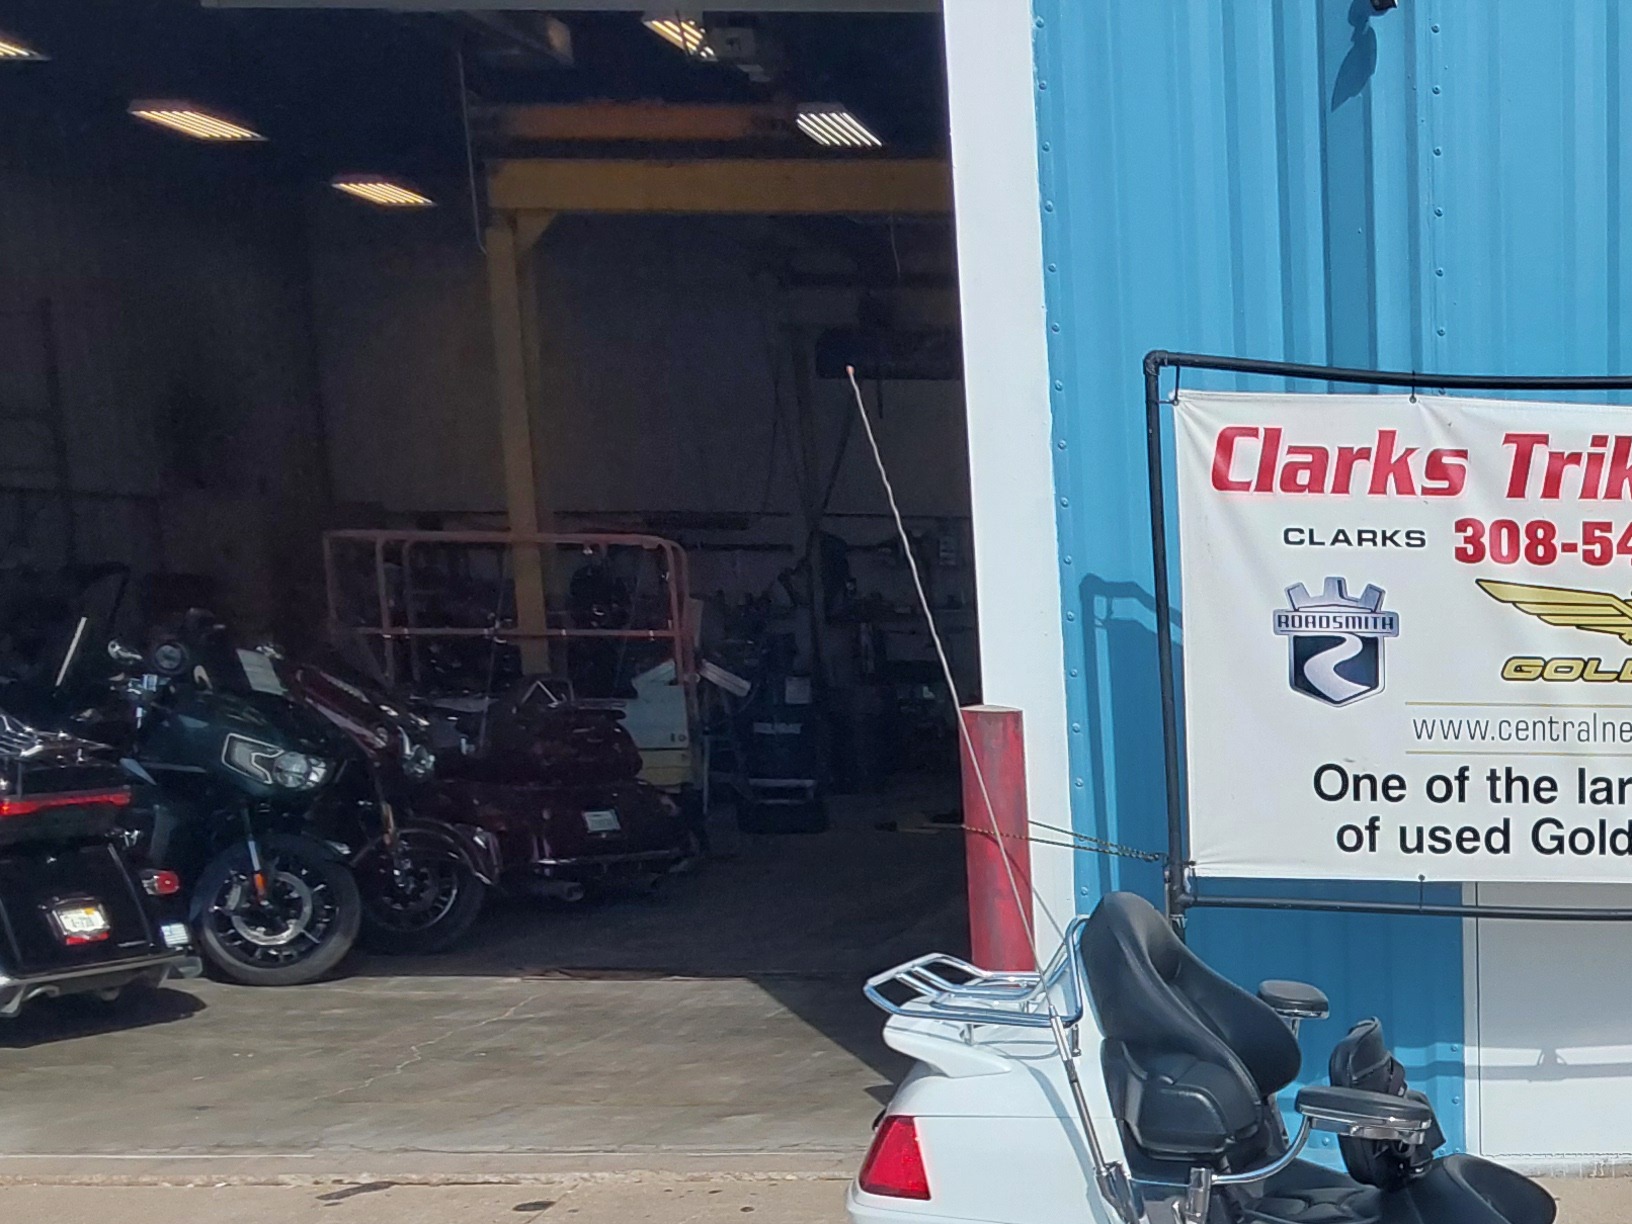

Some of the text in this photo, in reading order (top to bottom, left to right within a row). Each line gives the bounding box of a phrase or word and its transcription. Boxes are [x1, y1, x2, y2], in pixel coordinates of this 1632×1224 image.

[1210, 426, 1469, 497] Clarks
[1282, 527, 1428, 549] CLARKS
[1276, 613, 1394, 632] ROADSMITH
[1312, 763, 1407, 802] One
[1425, 765, 1470, 803] of
[1485, 766, 1559, 804] the
[1336, 816, 1381, 853] of
[1399, 817, 1512, 856] used
